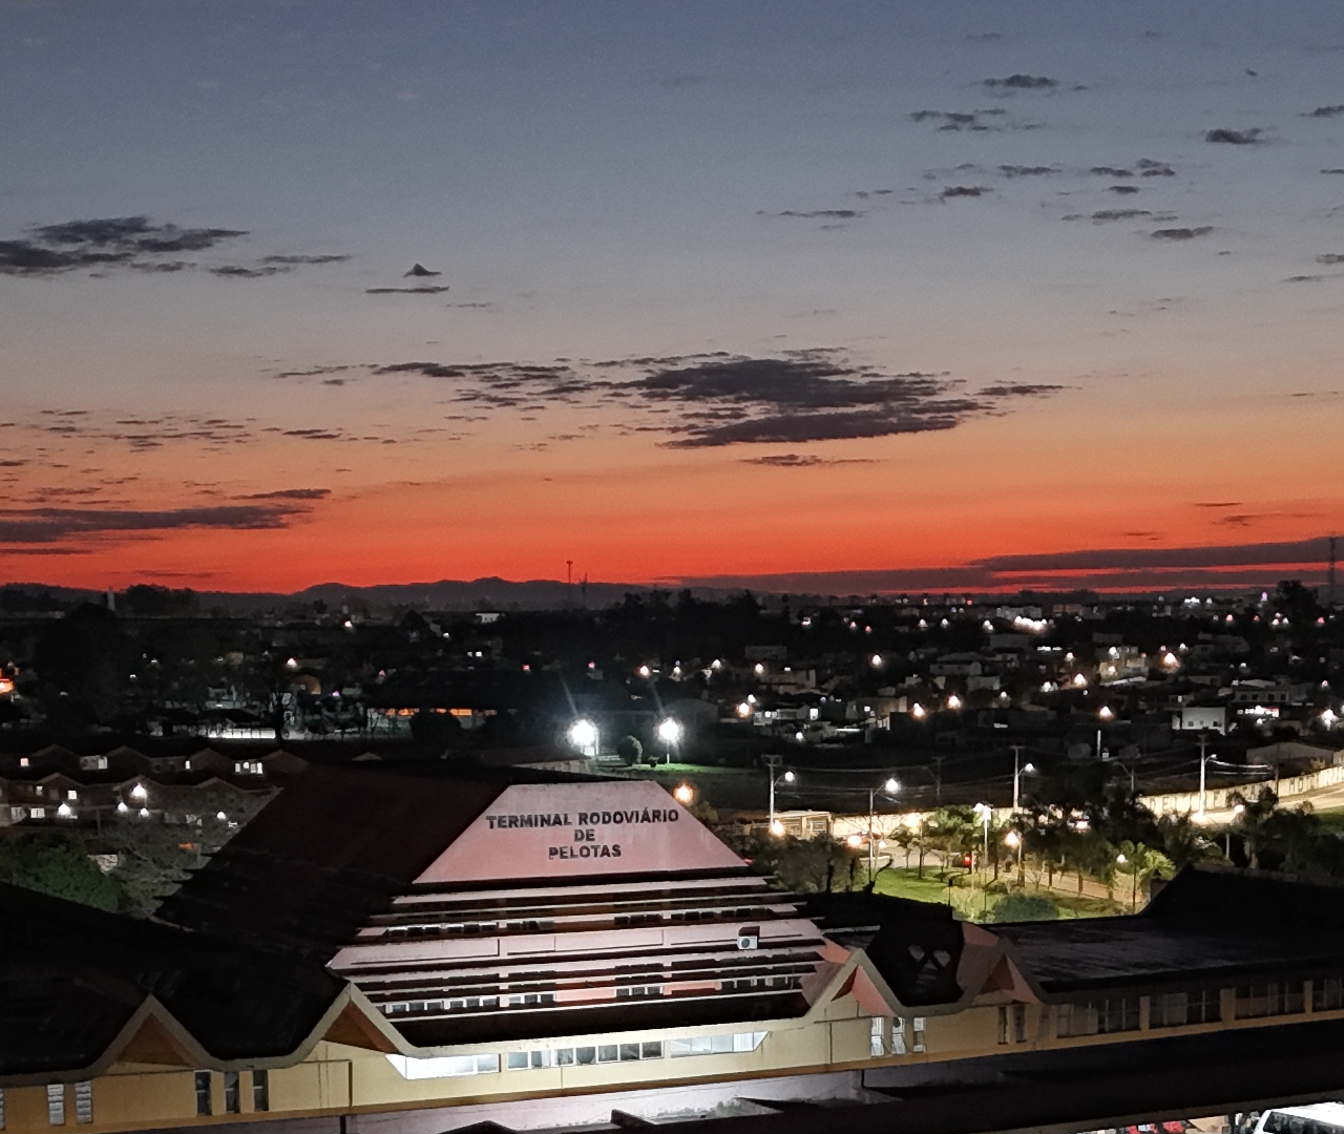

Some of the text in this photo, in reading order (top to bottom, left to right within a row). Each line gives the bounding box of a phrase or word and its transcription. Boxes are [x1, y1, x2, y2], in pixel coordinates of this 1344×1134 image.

[486, 807, 680, 829] TERMINAL RODOVIÁRIO
[574, 829, 596, 842] DE
[549, 844, 622, 860] PELOTAS
